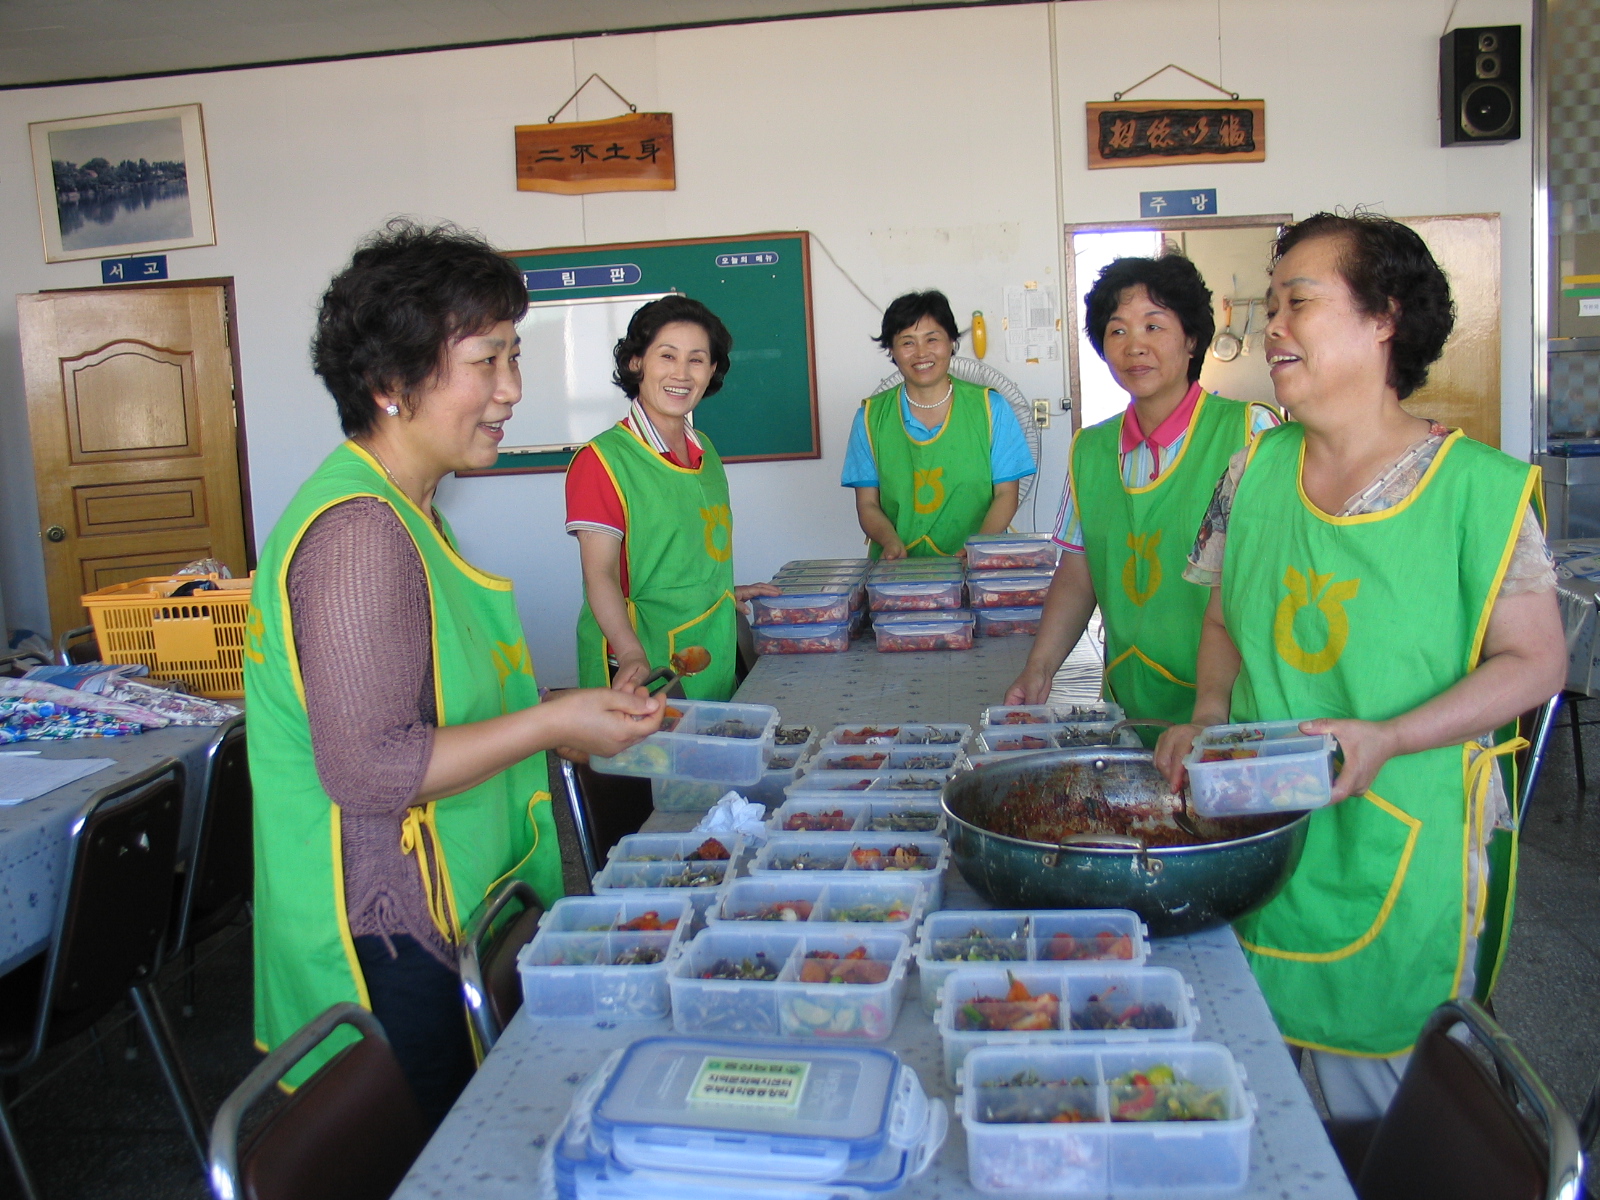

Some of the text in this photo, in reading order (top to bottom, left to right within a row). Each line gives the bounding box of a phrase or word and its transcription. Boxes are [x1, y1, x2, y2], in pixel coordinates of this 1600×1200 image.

[1150, 193, 1209, 213] 주방
[721, 254, 773, 265] 오늘의 메뉴
[109, 262, 160, 279] 서고
